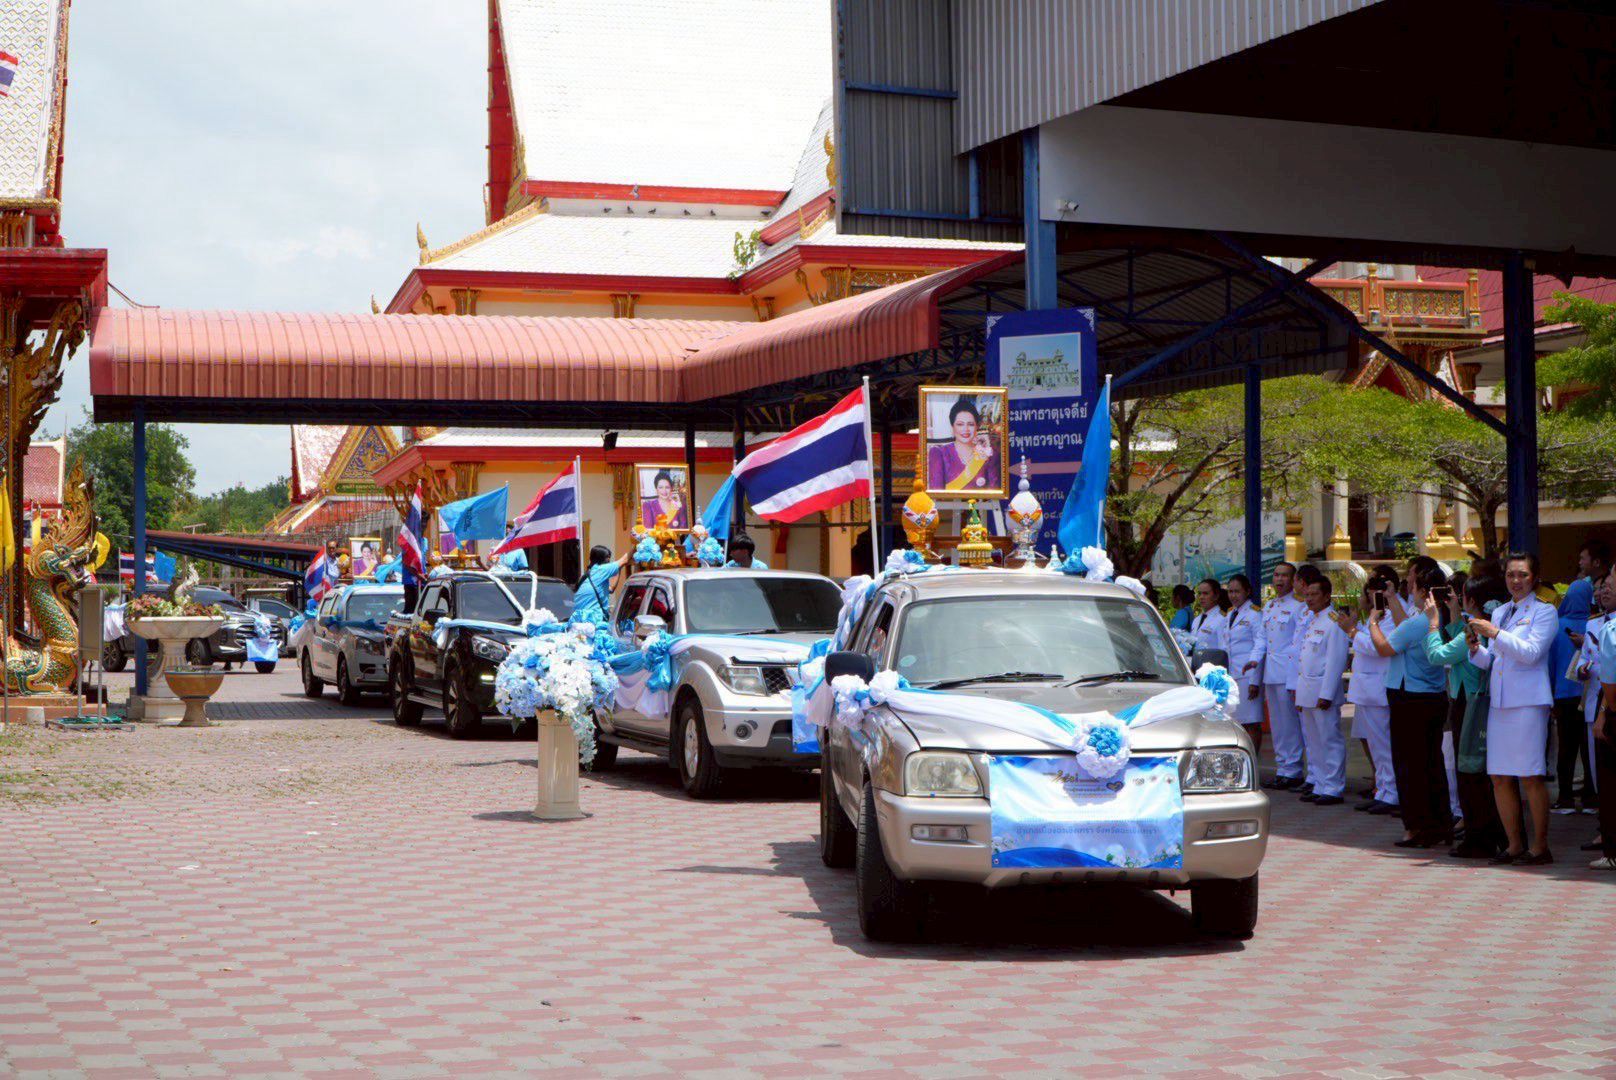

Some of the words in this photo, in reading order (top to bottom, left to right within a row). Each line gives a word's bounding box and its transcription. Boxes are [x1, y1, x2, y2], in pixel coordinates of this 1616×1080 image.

[1008, 402, 1088, 425] ะมหาธาตุเจดีย์
[1008, 431, 1083, 452] รีพุทธวรญาณ
